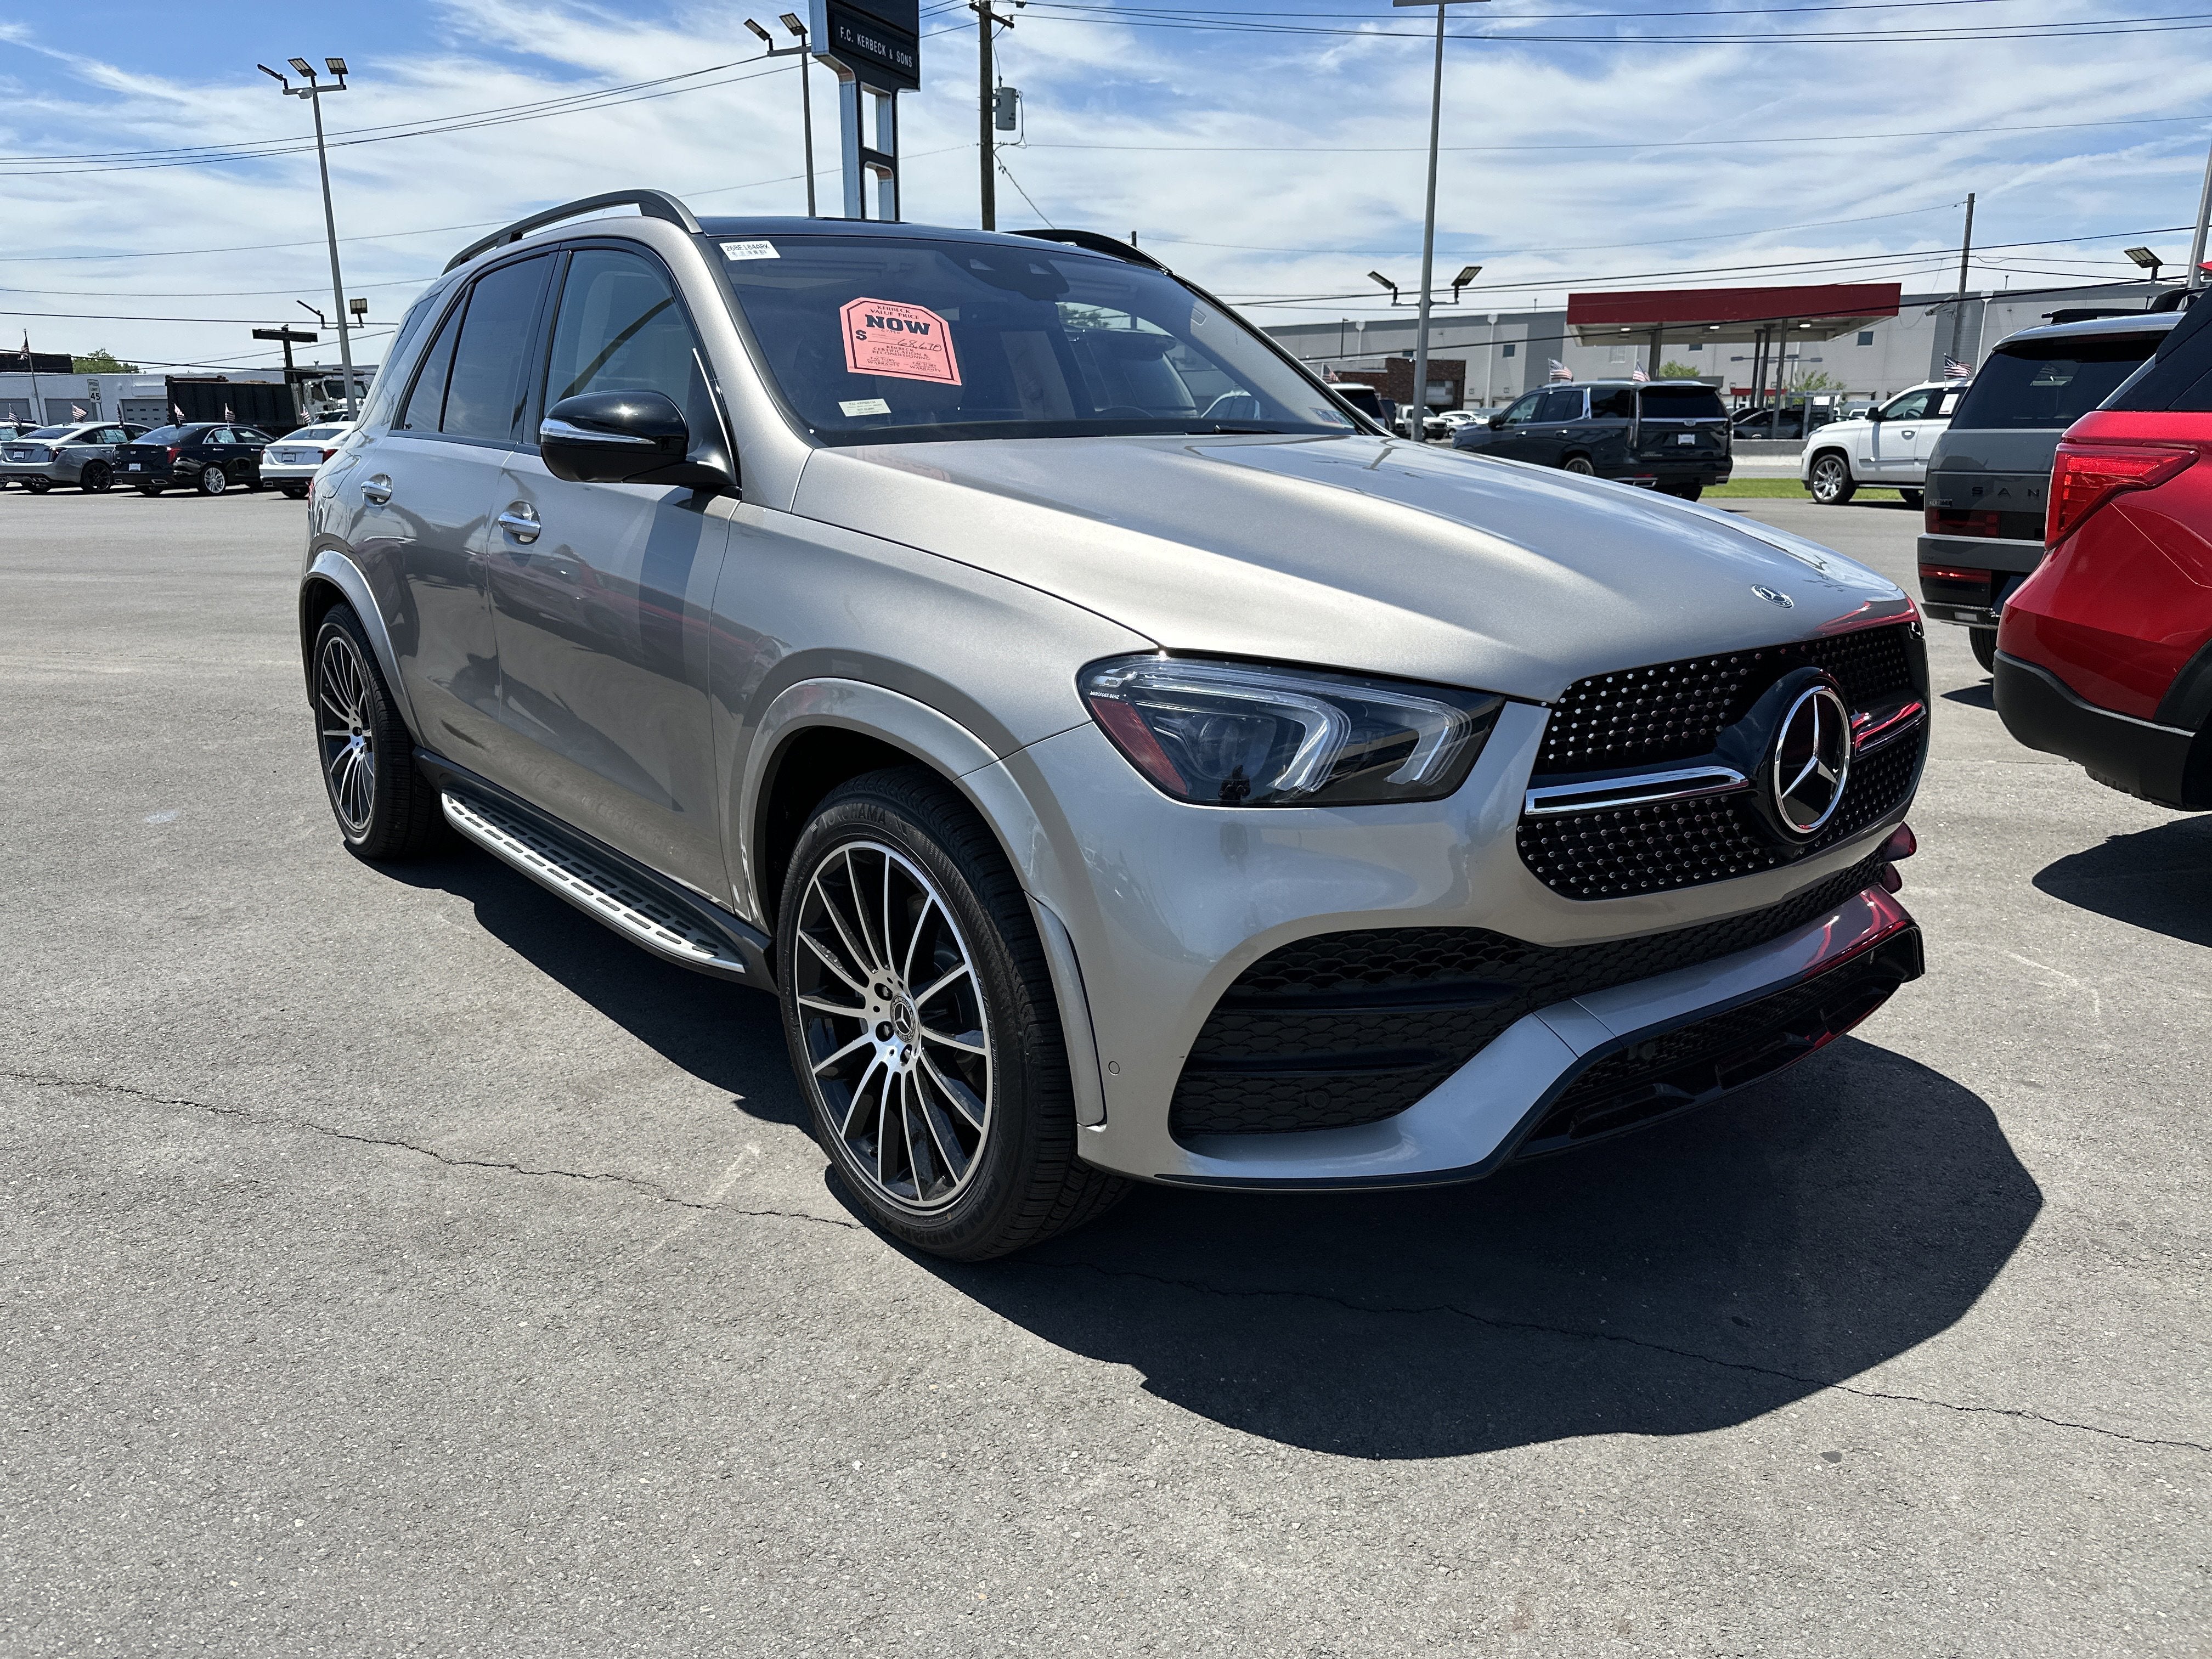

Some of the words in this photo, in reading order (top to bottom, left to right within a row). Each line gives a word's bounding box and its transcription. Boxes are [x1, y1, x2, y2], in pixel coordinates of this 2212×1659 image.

[840, 26, 854, 43] F.C.
[857, 33, 887, 57] KERBECK
[889, 49, 893, 60] &
[896, 50, 912, 68] SONS
[877, 305, 911, 314] KERBECK
[865, 314, 930, 335] NOW
[855, 329, 867, 341] $
[91, 392, 100, 400] 45
